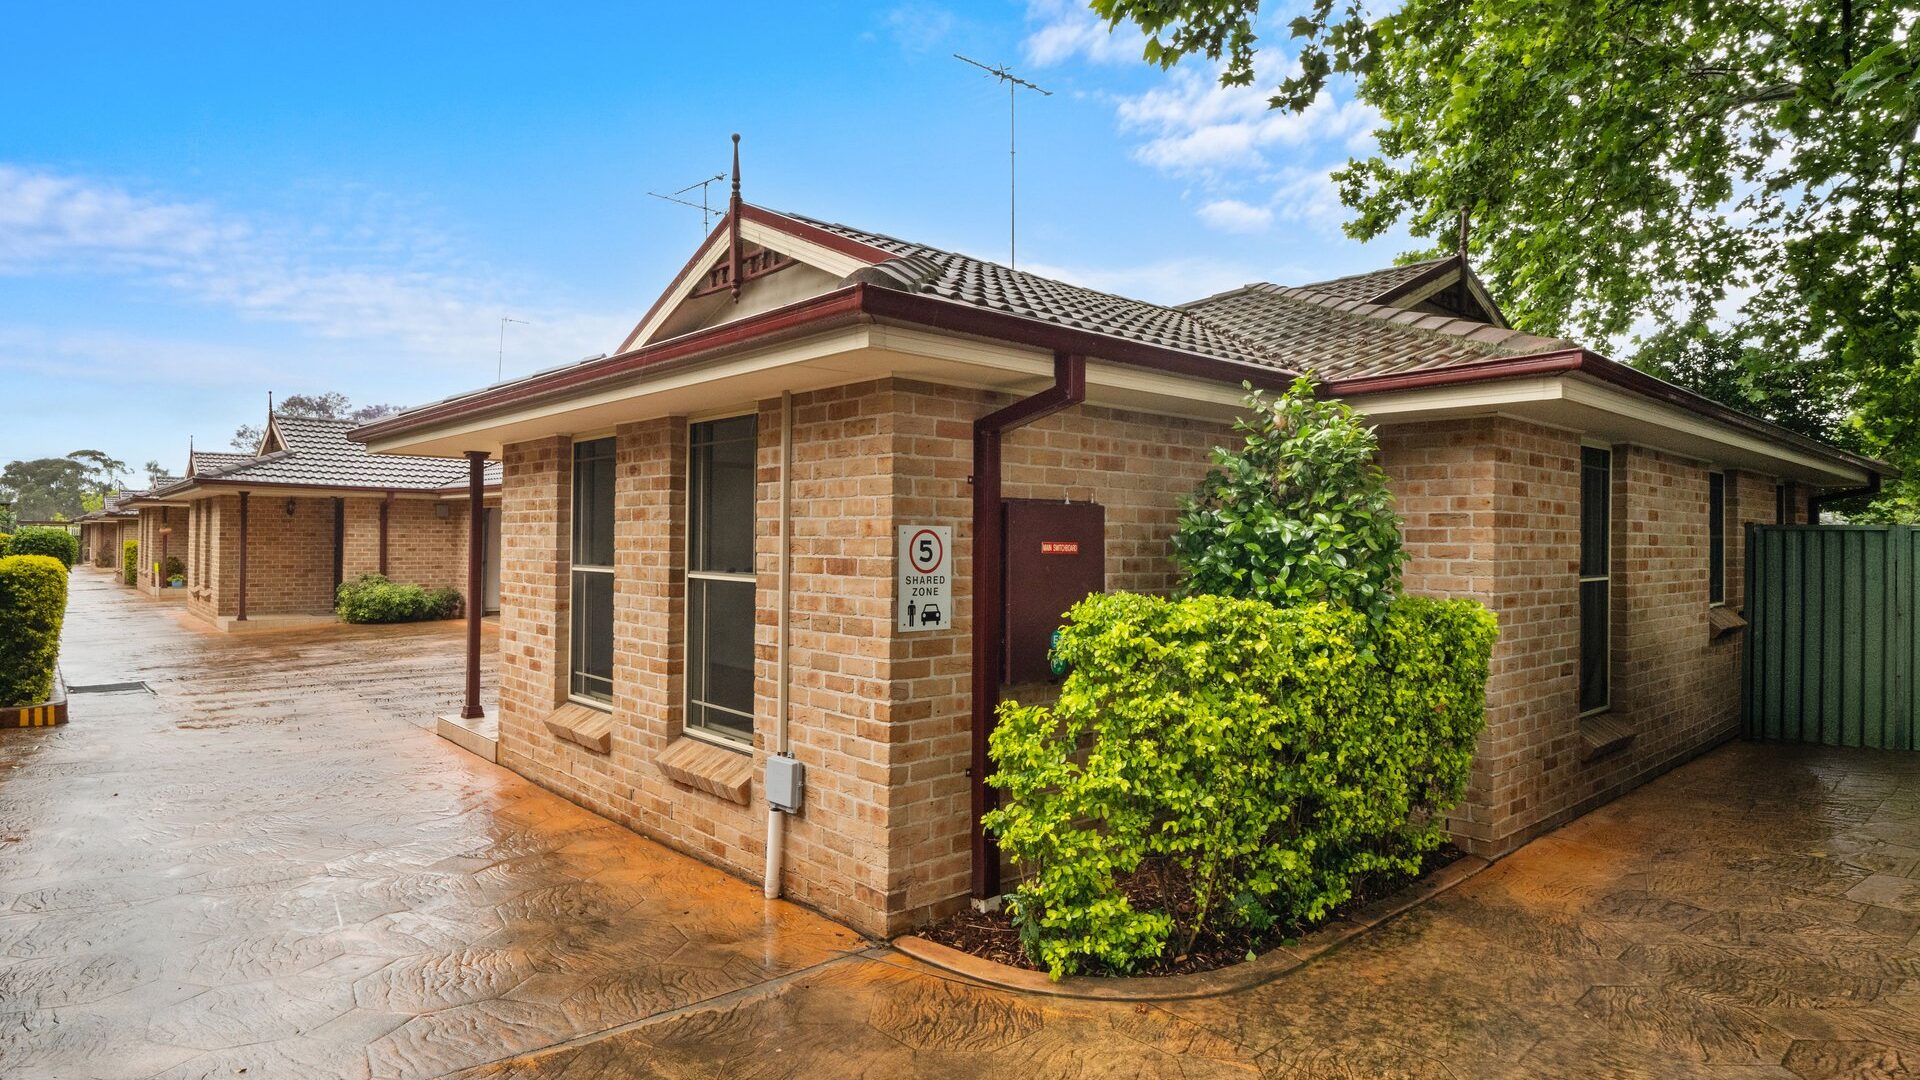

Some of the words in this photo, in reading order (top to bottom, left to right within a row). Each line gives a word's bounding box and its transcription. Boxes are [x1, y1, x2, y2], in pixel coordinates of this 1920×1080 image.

[919, 540, 933, 562] 5
[905, 575, 945, 585] SHARED
[912, 587, 939, 597] ZONE
